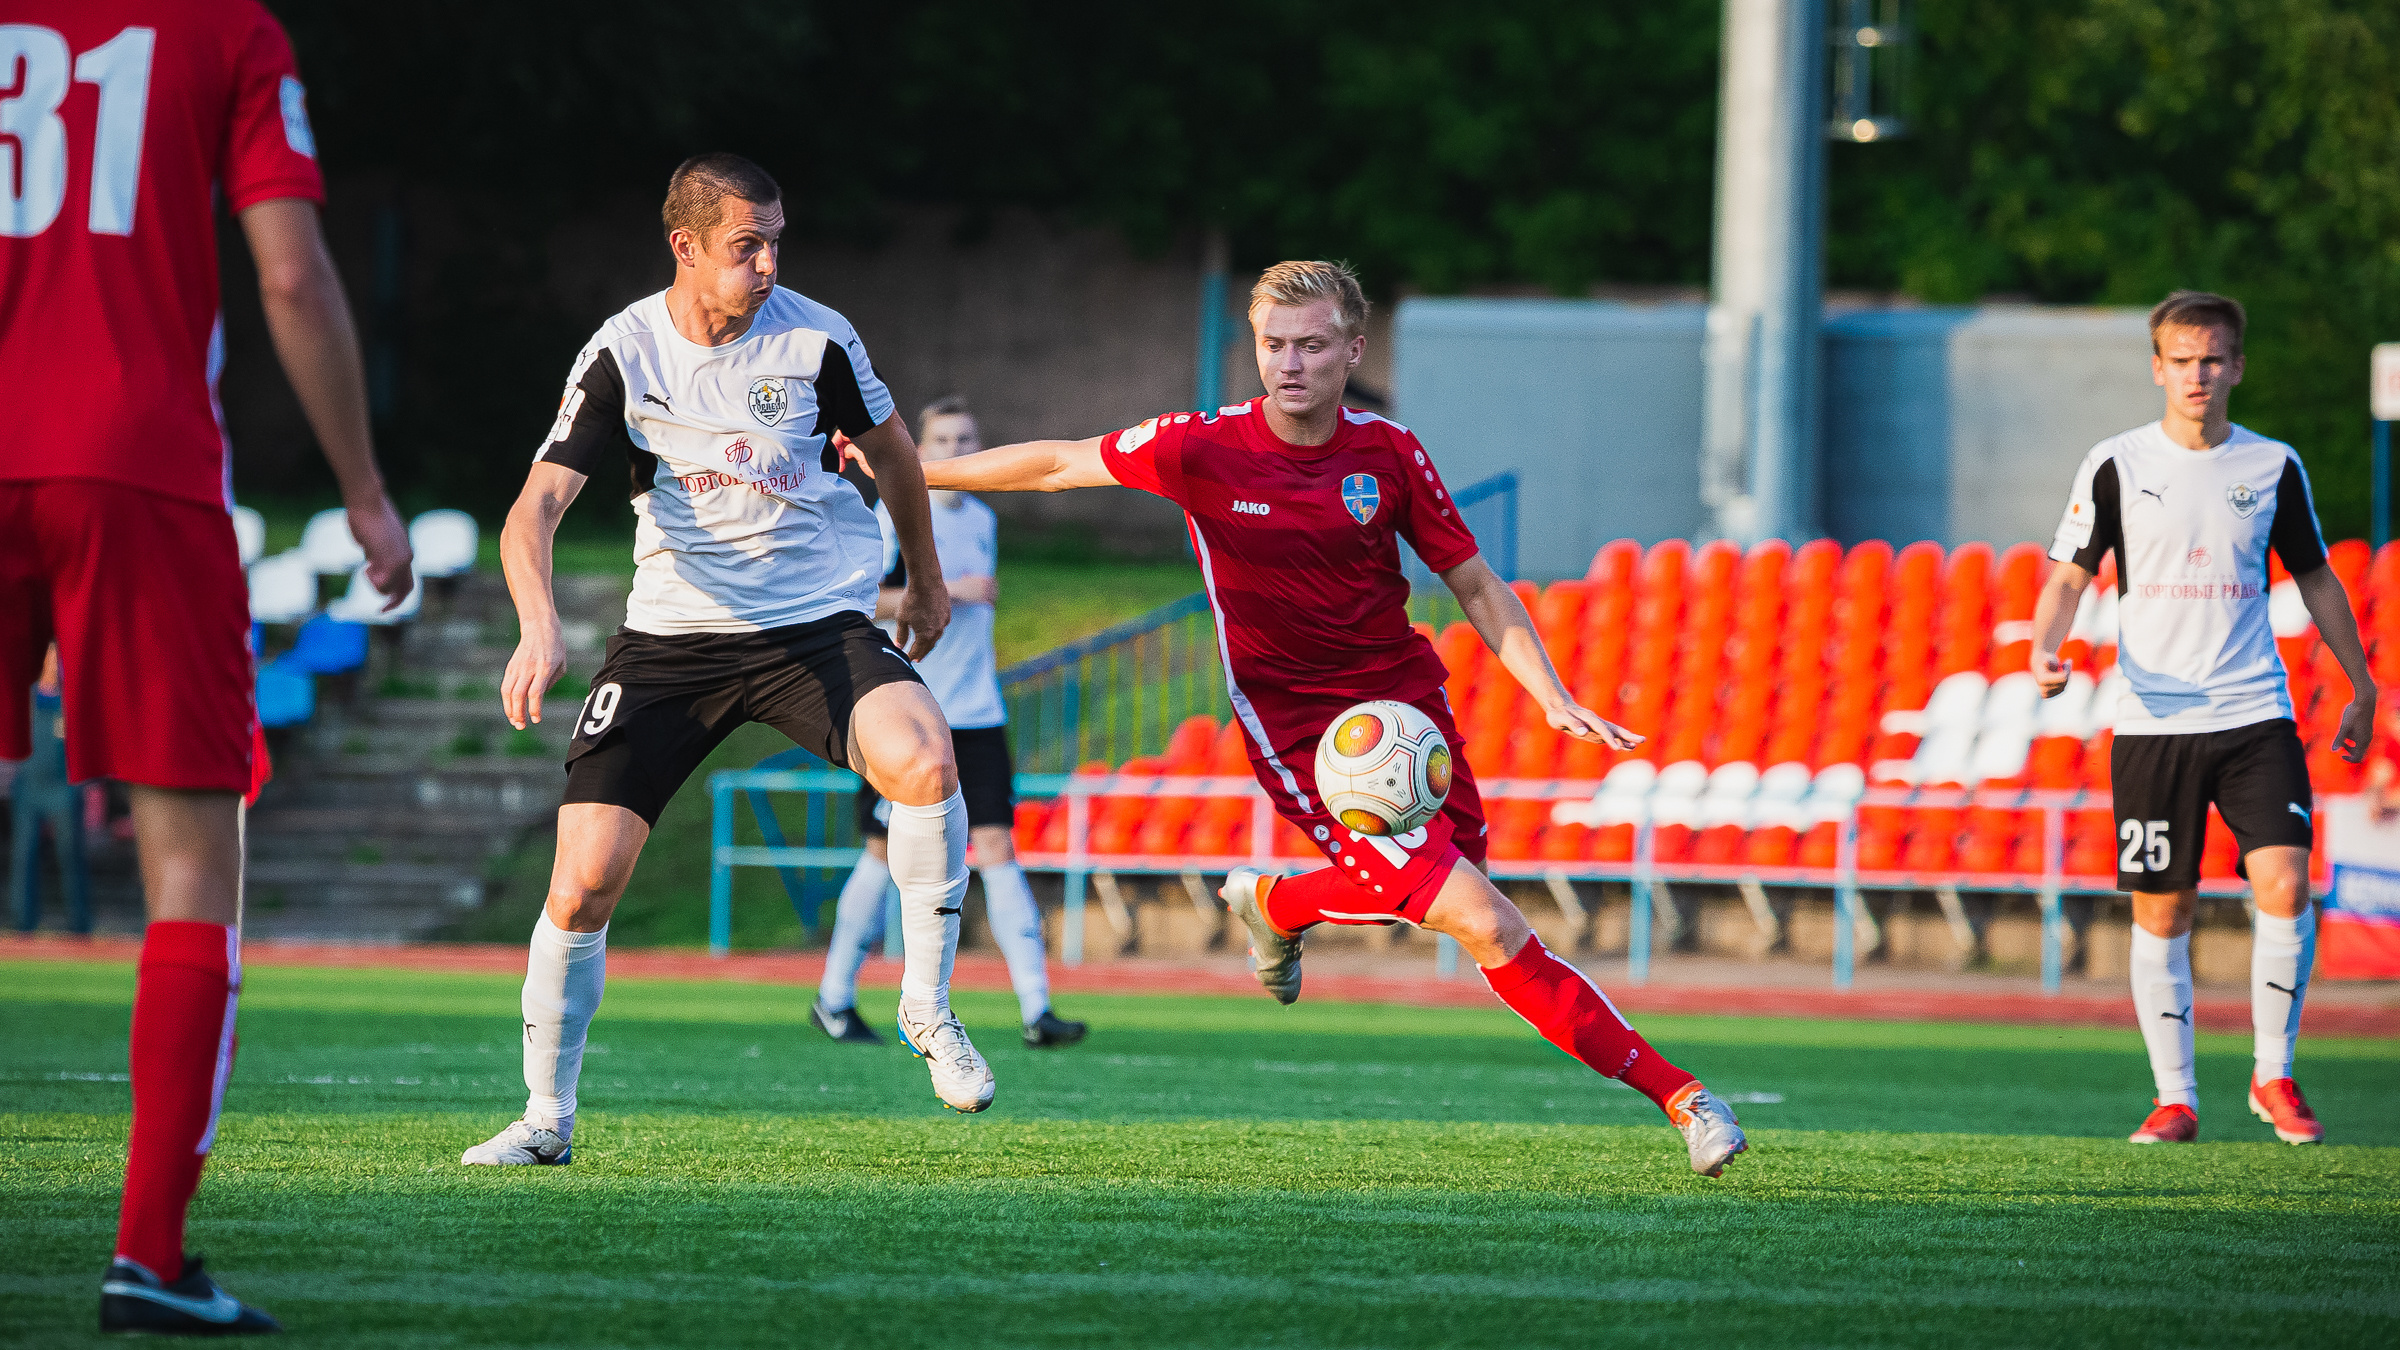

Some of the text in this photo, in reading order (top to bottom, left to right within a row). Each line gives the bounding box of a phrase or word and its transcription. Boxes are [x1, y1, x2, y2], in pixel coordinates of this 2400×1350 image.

[0, 23, 156, 238] 31
[769, 462, 806, 492] РЯДЫ
[1232, 500, 1270, 515] JAKO
[2138, 583, 2258, 600] ТОРГОВЫЕ РЯДЫ
[2119, 818, 2171, 873] 25
